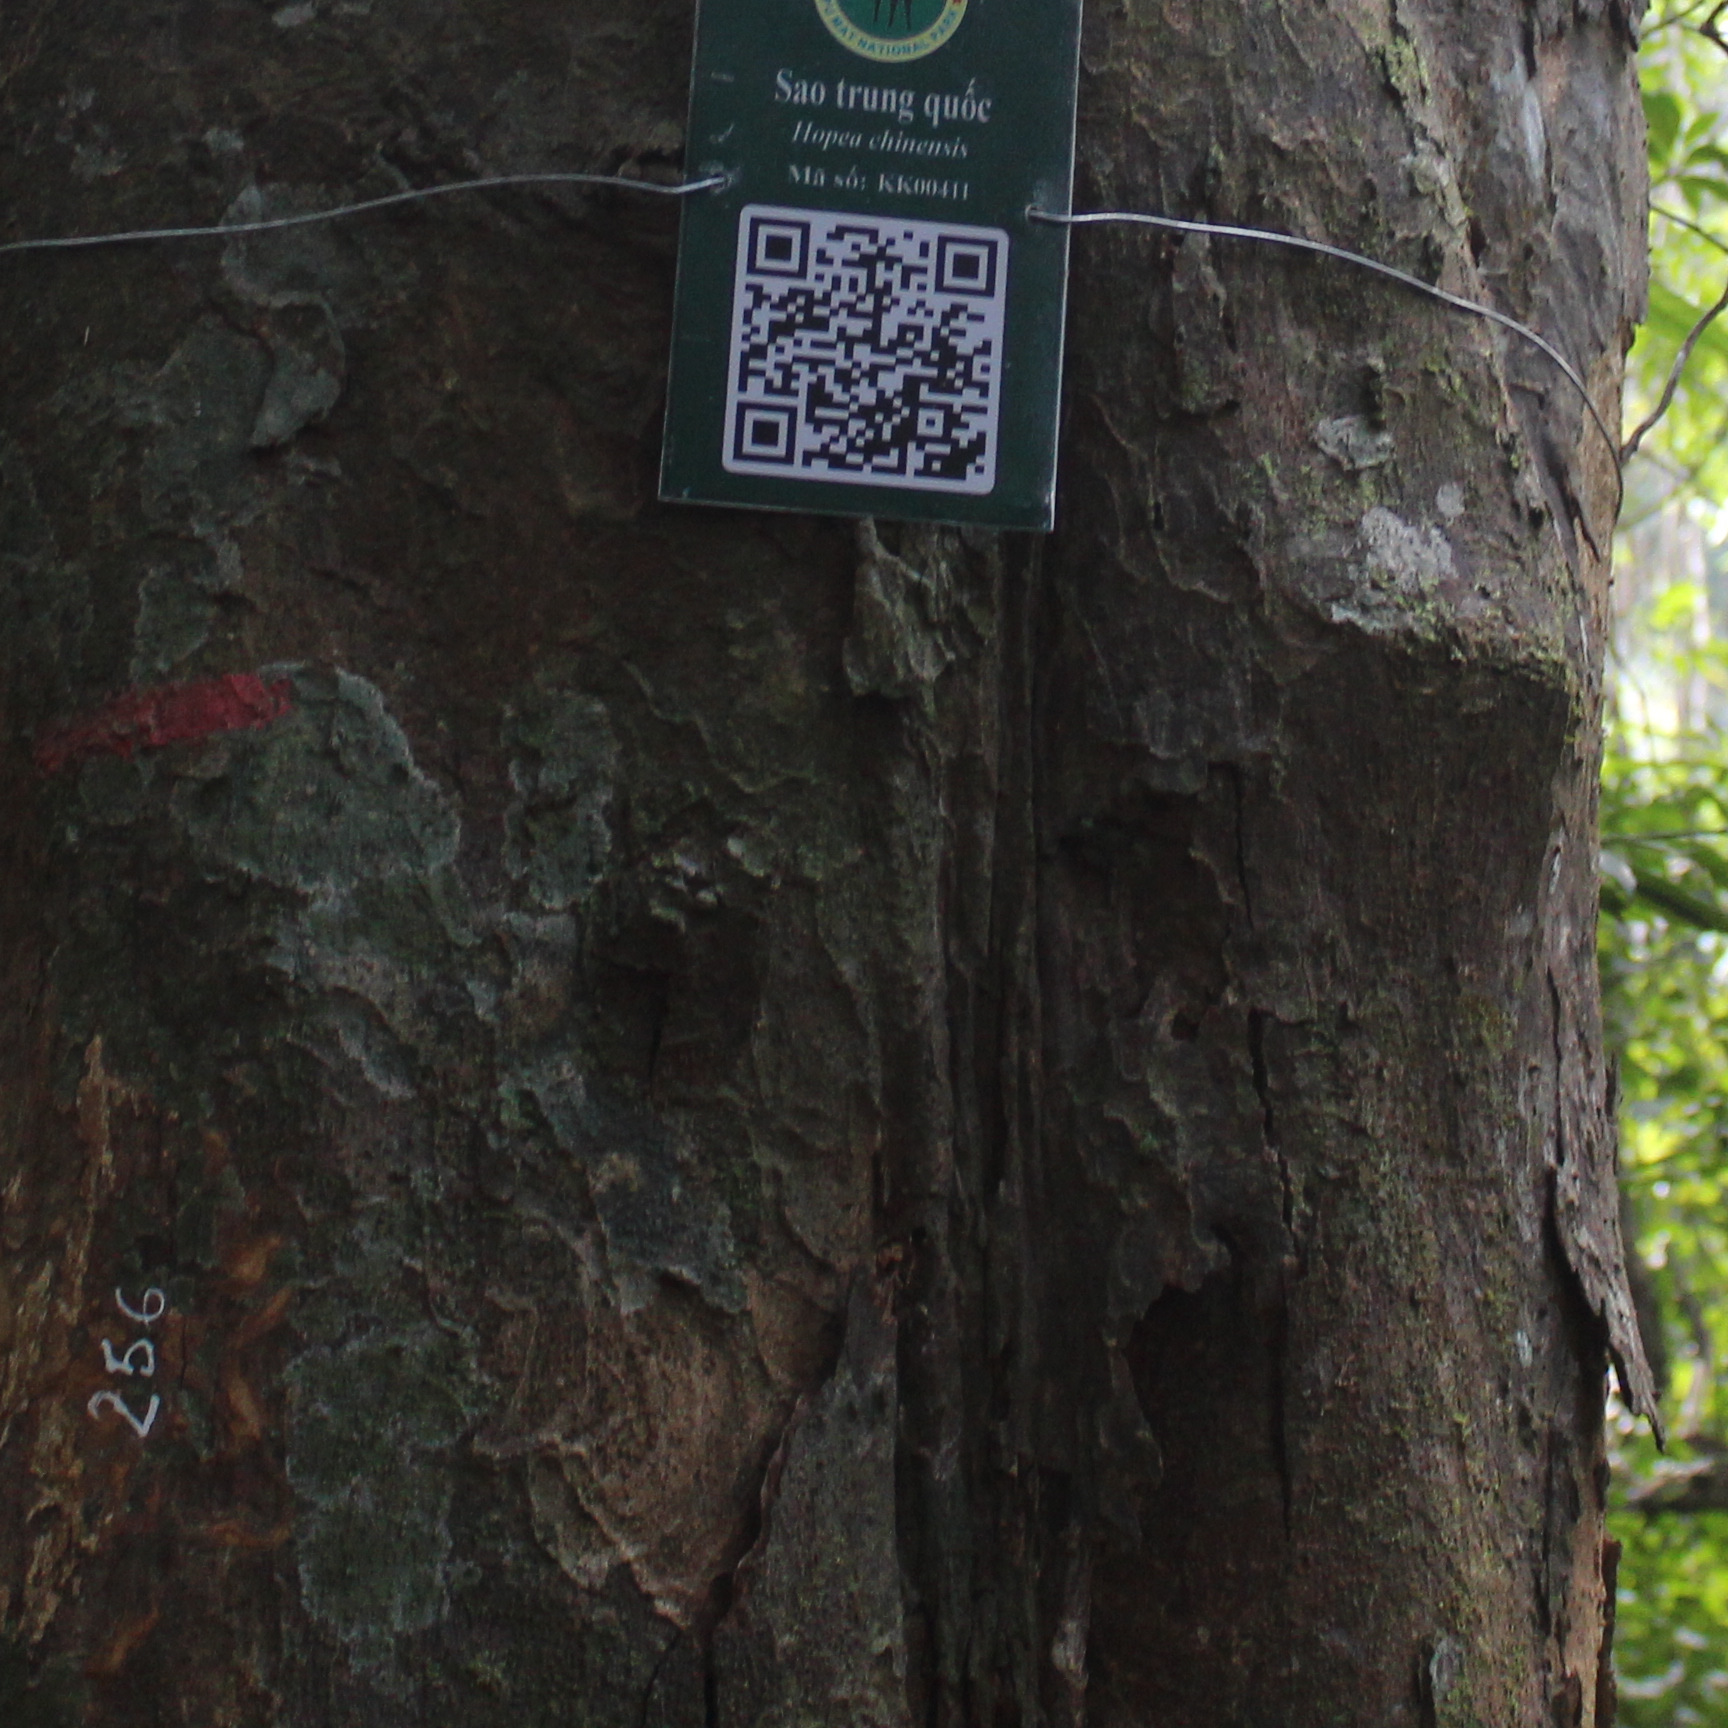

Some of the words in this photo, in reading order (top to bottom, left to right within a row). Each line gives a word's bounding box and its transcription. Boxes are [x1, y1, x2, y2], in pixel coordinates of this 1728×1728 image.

[857, 38, 929, 55] NATIONAL
[930, 10, 957, 41] PARK
[774, 68, 826, 106] Sao
[836, 77, 915, 124] trung
[924, 77, 992, 129] quốc
[791, 120, 862, 151] Hopea
[869, 129, 968, 159] chinensis
[789, 164, 825, 187] Mã
[834, 165, 866, 191] số:
[878, 173, 968, 200] KK00411
[87, 1285, 165, 1438] 256
